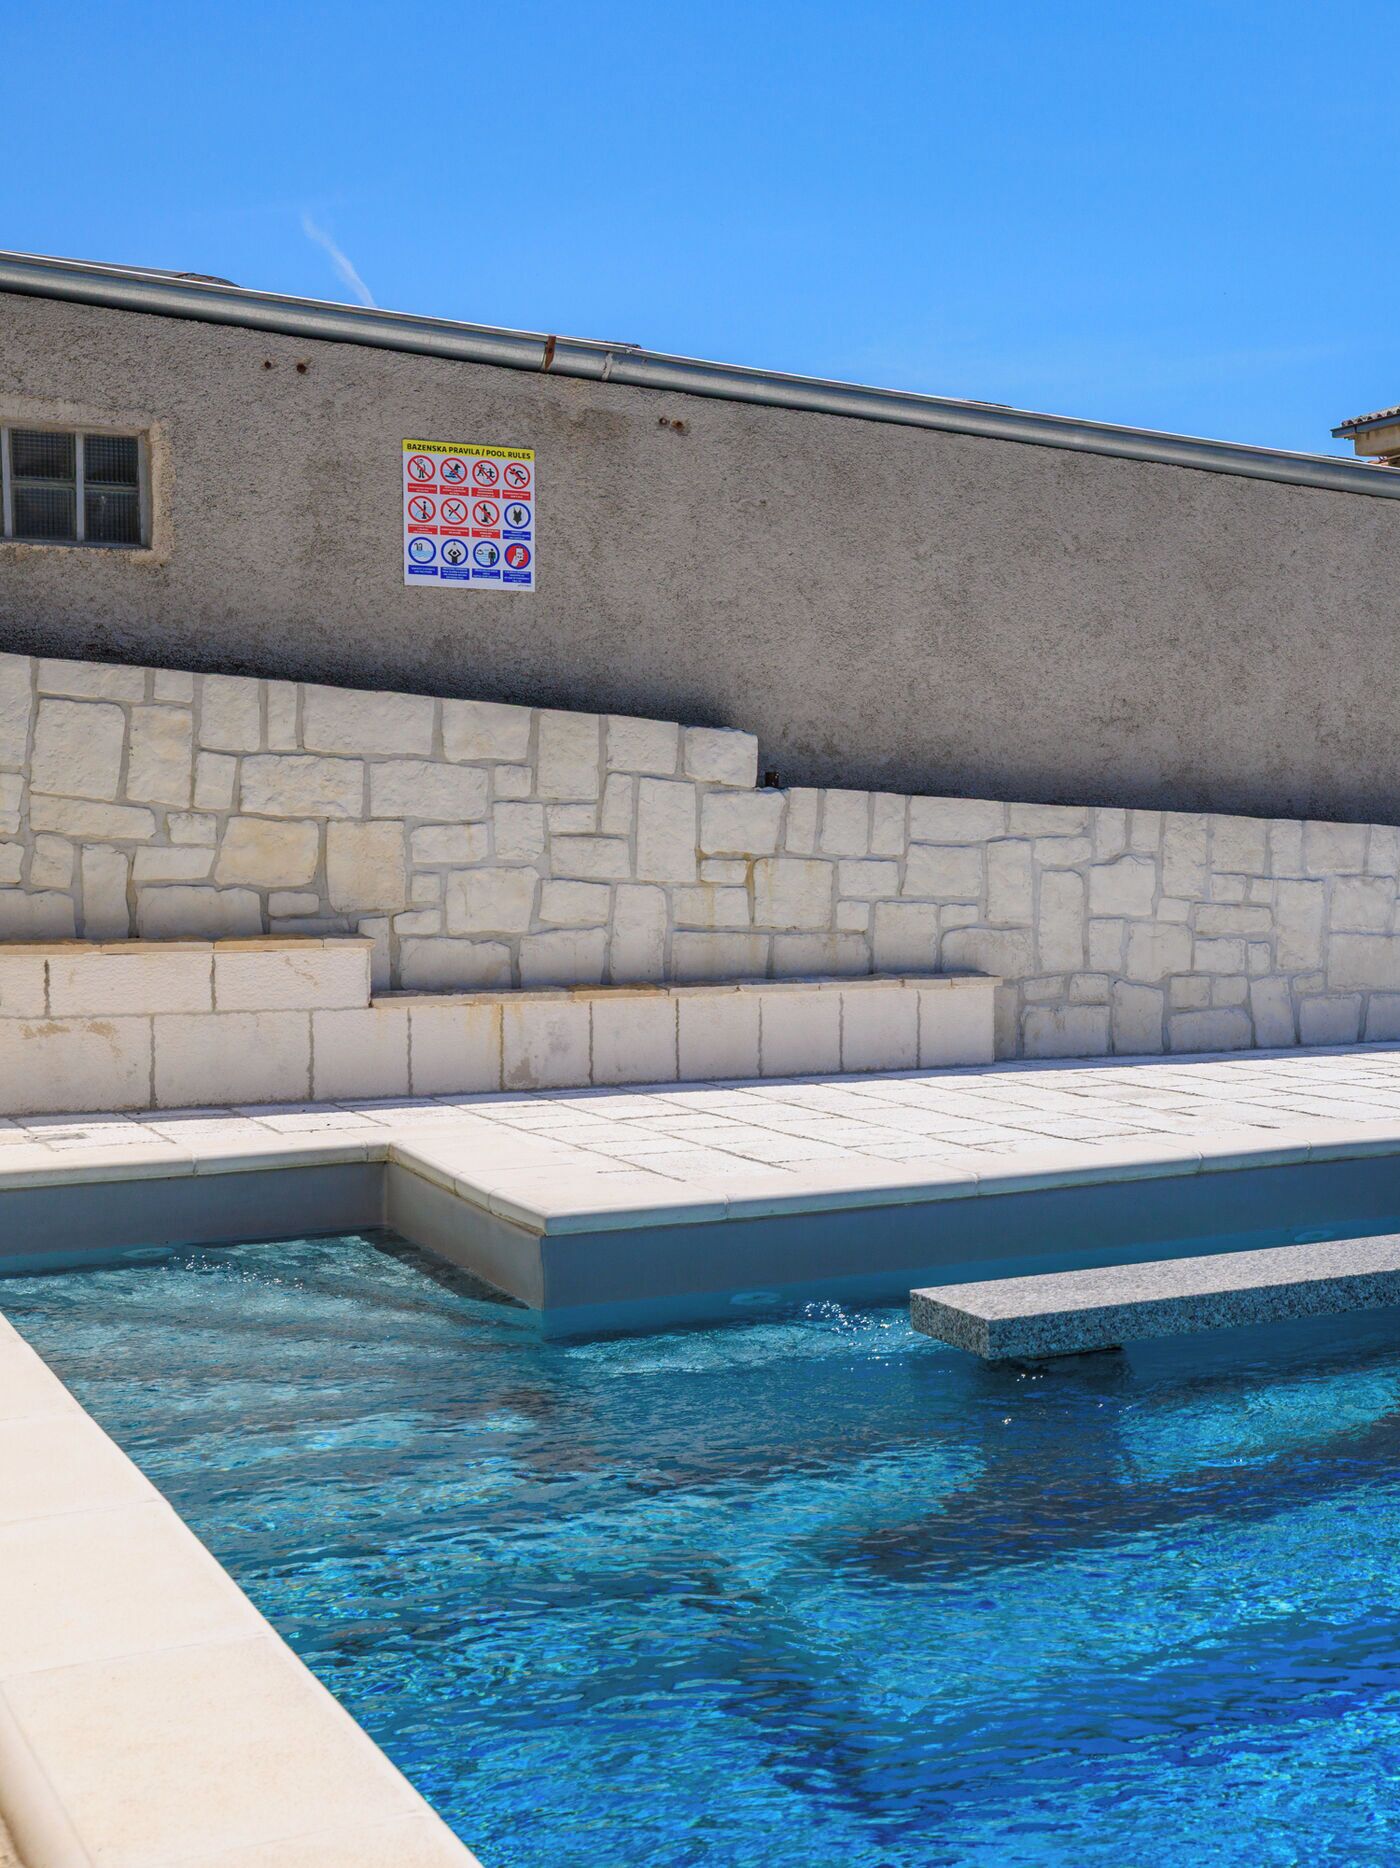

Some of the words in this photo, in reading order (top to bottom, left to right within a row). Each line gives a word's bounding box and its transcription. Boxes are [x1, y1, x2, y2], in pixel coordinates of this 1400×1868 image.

[407, 443, 447, 453] BAZENSKA
[449, 447, 480, 455] PRAVILA
[486, 450, 506, 458] POOL
